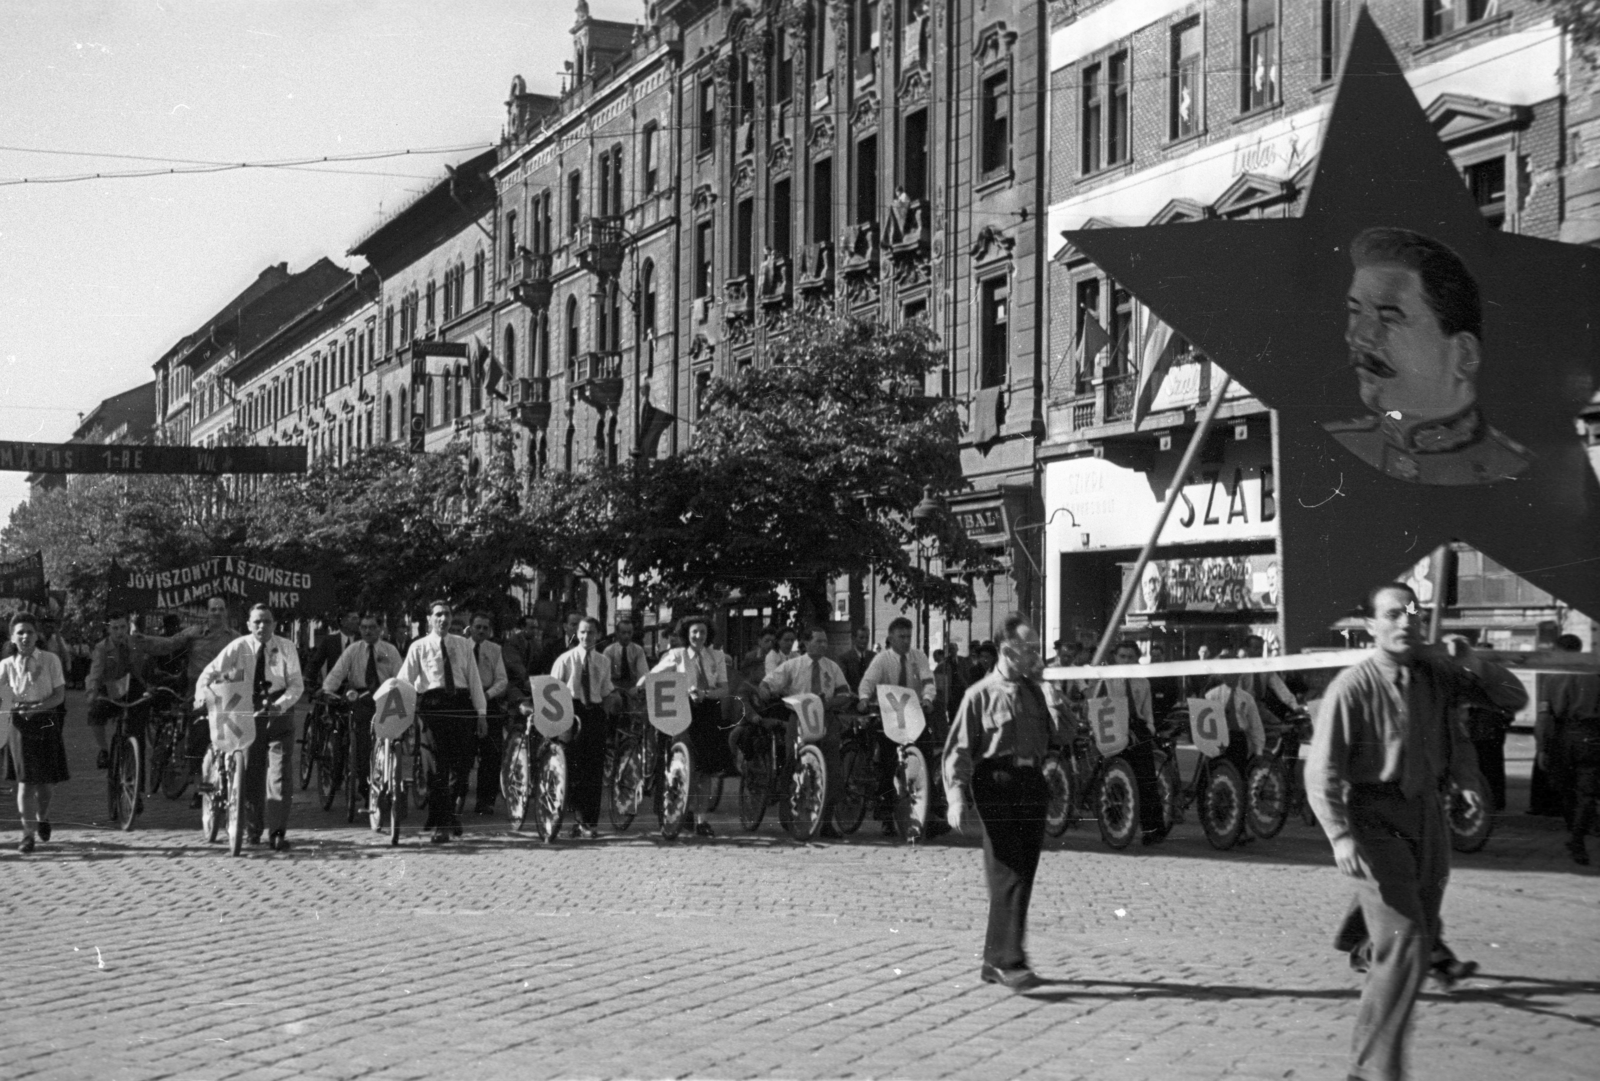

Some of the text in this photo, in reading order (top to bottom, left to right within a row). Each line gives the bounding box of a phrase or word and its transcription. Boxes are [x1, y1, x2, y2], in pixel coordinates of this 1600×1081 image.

[102, 448, 144, 470] 1-RE
[1178, 466, 1276, 529] SZAB
[225, 555, 234, 573] A
[268, 590, 301, 609] MKP
[214, 692, 244, 740] K
[541, 683, 564, 722] S
[654, 680, 677, 718] E
[885, 692, 911, 729] Y
[1196, 707, 1218, 740] G
